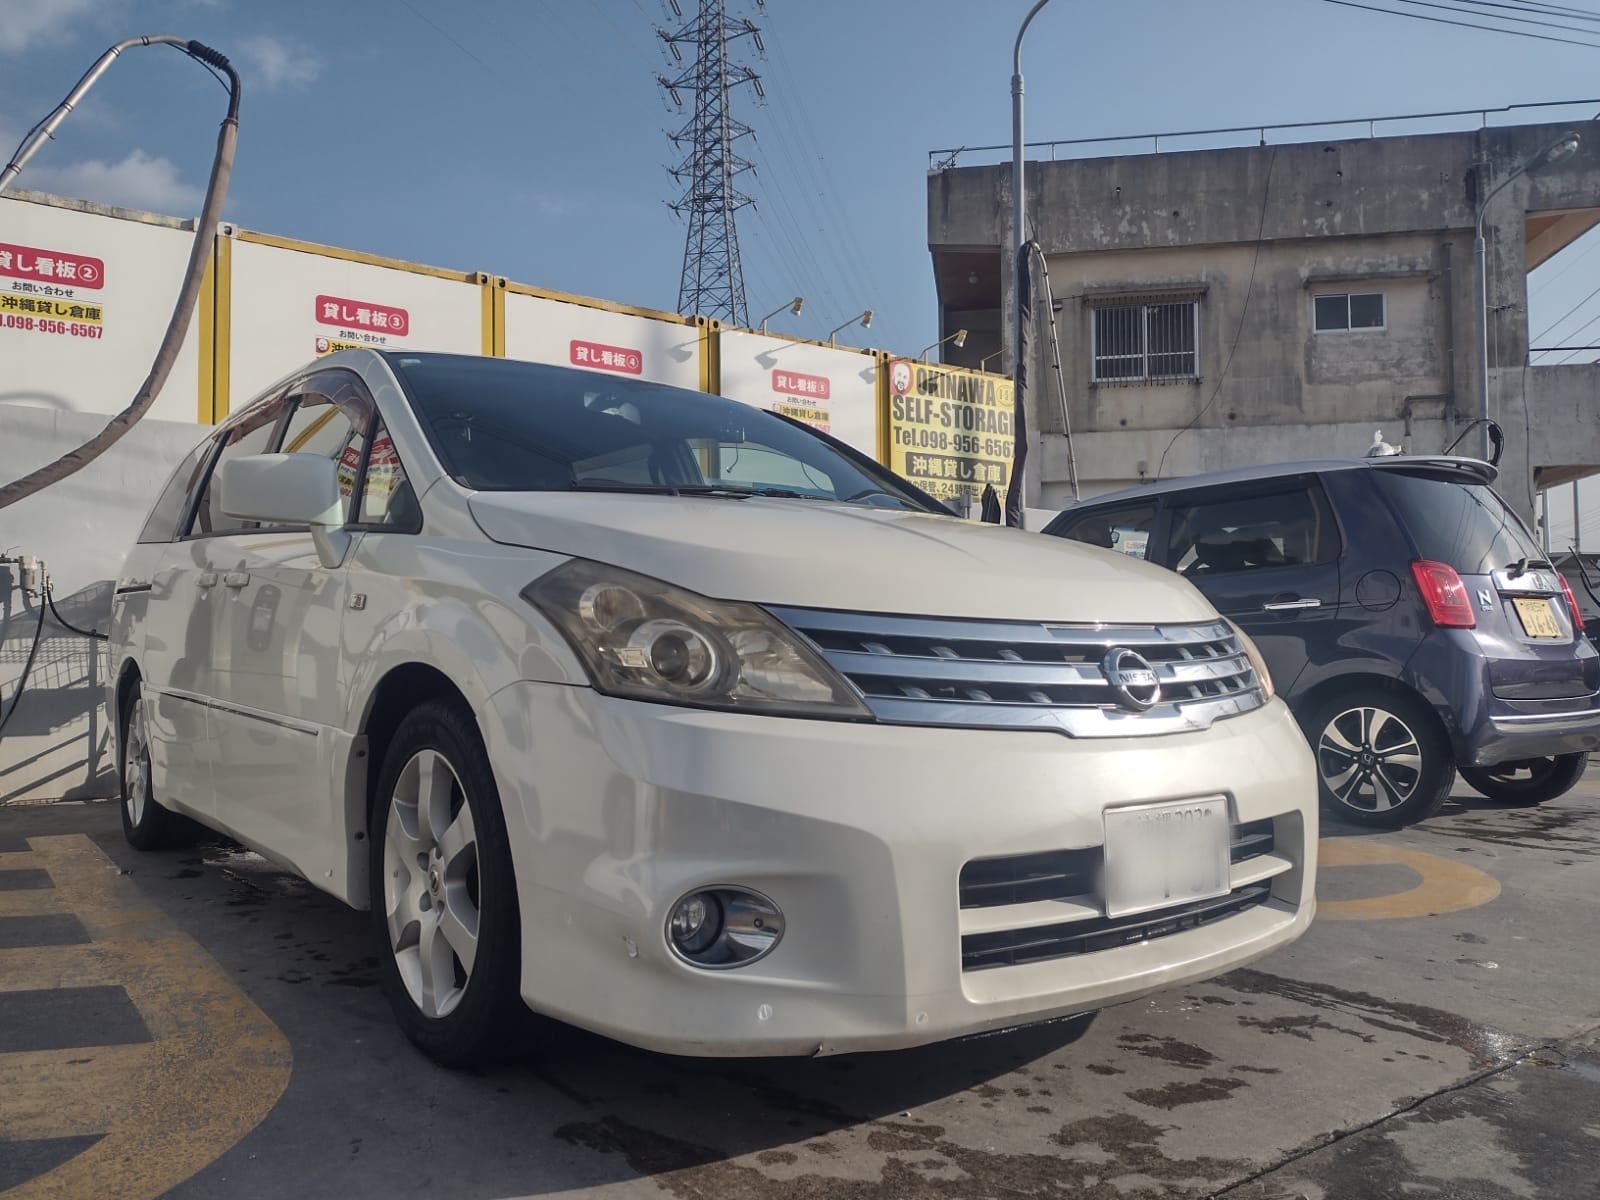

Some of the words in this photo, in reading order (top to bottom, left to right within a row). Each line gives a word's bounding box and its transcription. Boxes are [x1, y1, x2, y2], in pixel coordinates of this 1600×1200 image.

[12, 281, 74, 298] お問い合わせ
[2, 296, 101, 320] 沖縄貸し倉庫
[339, 330, 387, 344] お問い合わせ
[916, 367, 997, 406] OKINAWA
[912, 455, 1001, 483] 沖縄貸し倉庫
